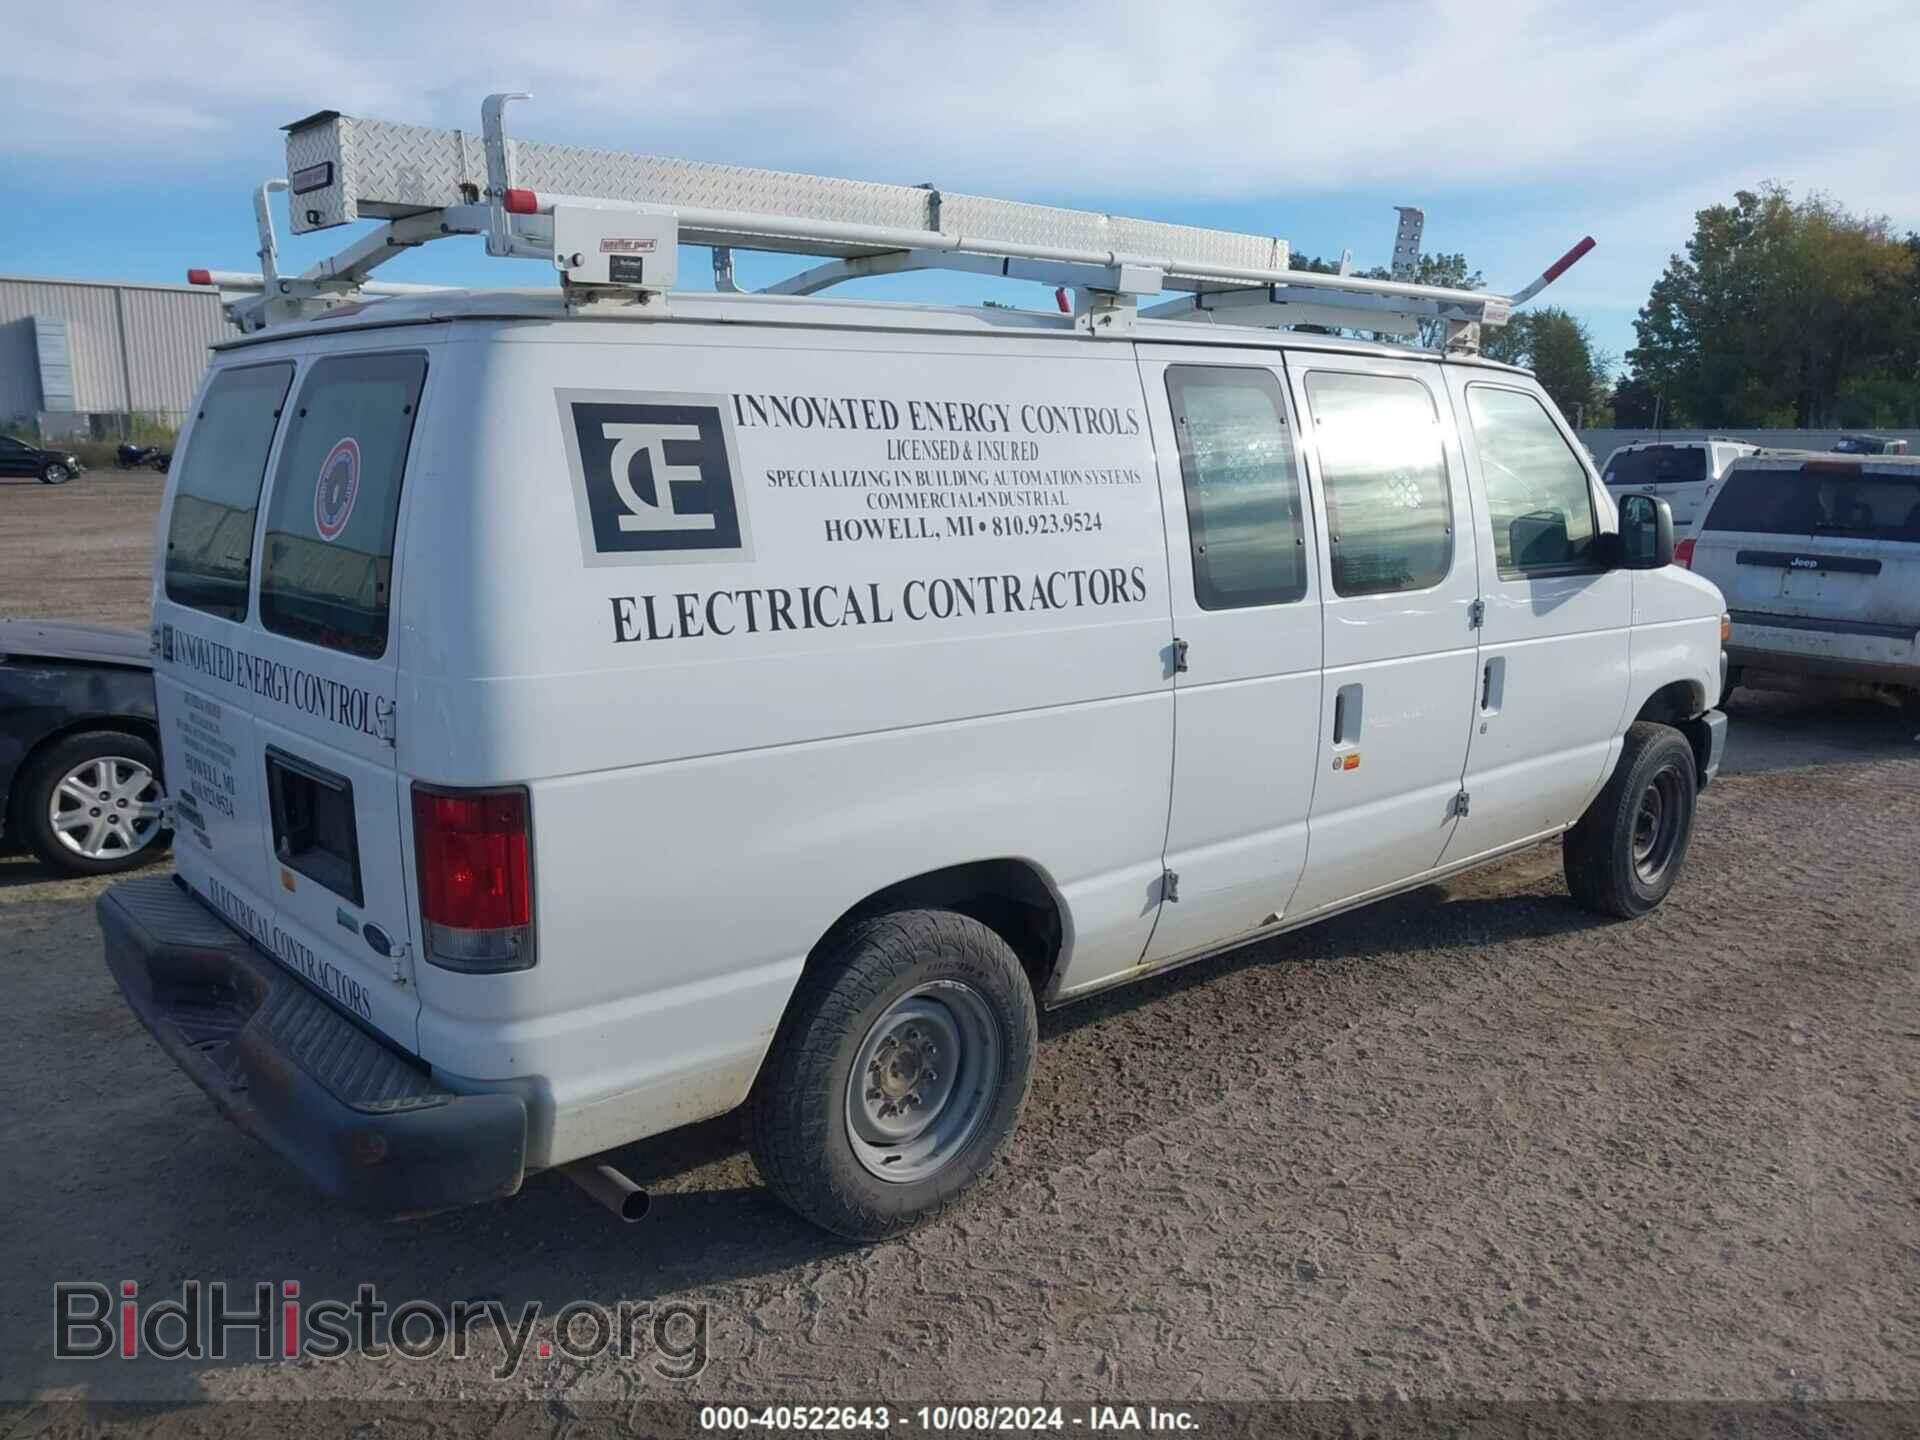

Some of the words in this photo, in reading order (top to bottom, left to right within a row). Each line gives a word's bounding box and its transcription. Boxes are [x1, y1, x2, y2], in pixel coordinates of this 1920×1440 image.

[732, 394, 899, 430] INNOVATED
[908, 400, 1010, 433] ENERGY
[1021, 404, 1140, 436] CONTROLS
[887, 439, 959, 461] LICENSED
[962, 440, 973, 461] &
[978, 440, 1039, 462] INSURED
[766, 470, 891, 488] SPECIALIZING
[894, 470, 912, 487] IN
[916, 470, 989, 487] BUILDING
[993, 469, 1083, 486] AUTOMATION
[1084, 469, 1142, 485] SYSTEMS
[824, 517, 941, 542] HOWELL,
[992, 512, 1103, 537] 810.923.9524
[1791, 557, 1818, 569] Jeep
[608, 583, 893, 643] ELECTRICAL
[902, 566, 1147, 621] CONTRACTORS
[174, 629, 234, 683] INNOVATED
[236, 655, 293, 705] ENERGY
[294, 669, 393, 740] CONTROLS
[273, 926, 372, 1021] CONTRACTORS
